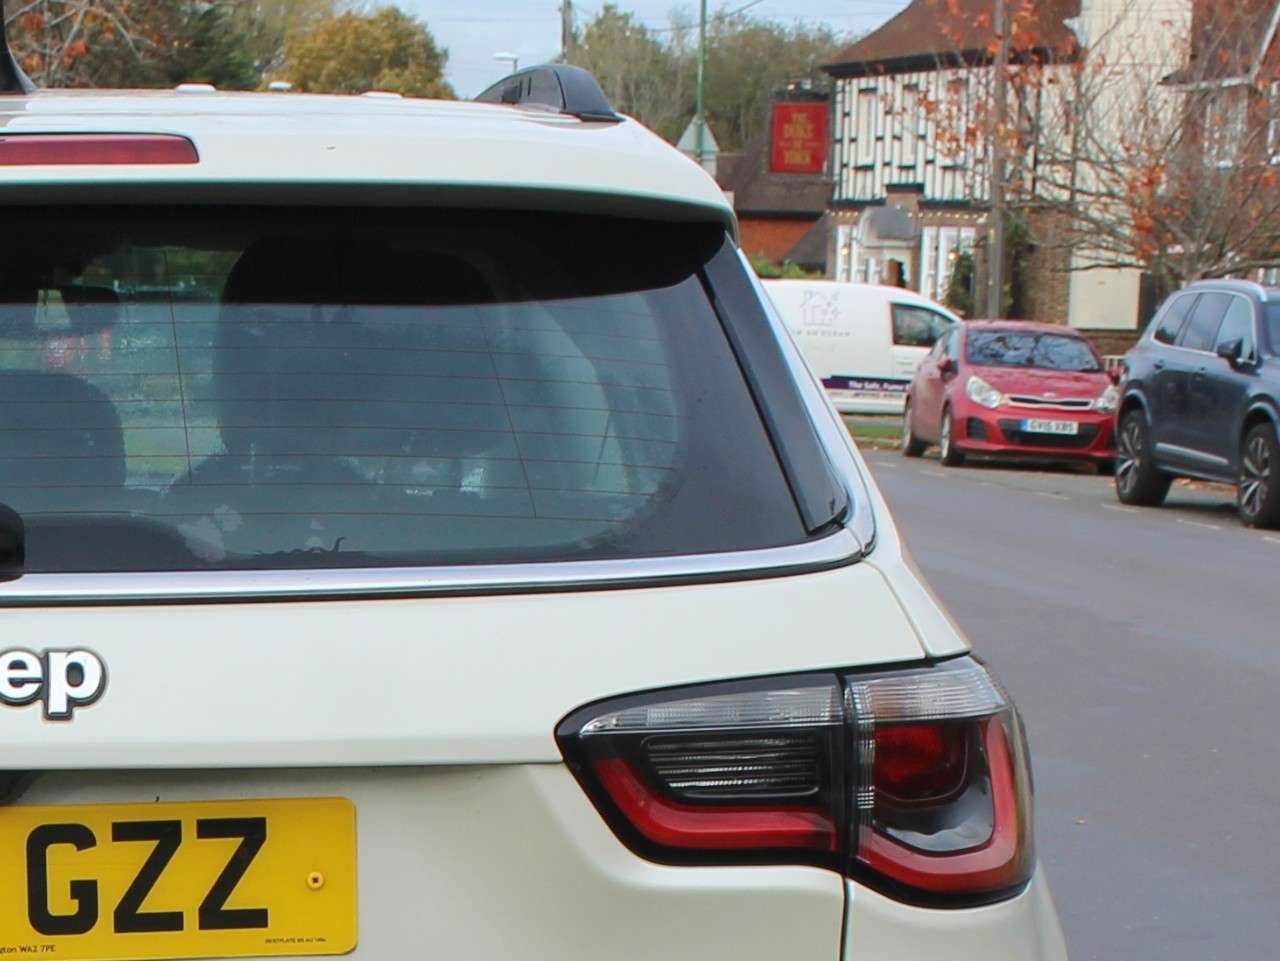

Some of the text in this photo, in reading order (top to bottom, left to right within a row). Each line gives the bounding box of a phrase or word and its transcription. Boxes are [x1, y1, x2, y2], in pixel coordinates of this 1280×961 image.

[25, 816, 270, 936] GZZ
[19, 944, 38, 953] WA2
[40, 944, 57, 953] 7PE
